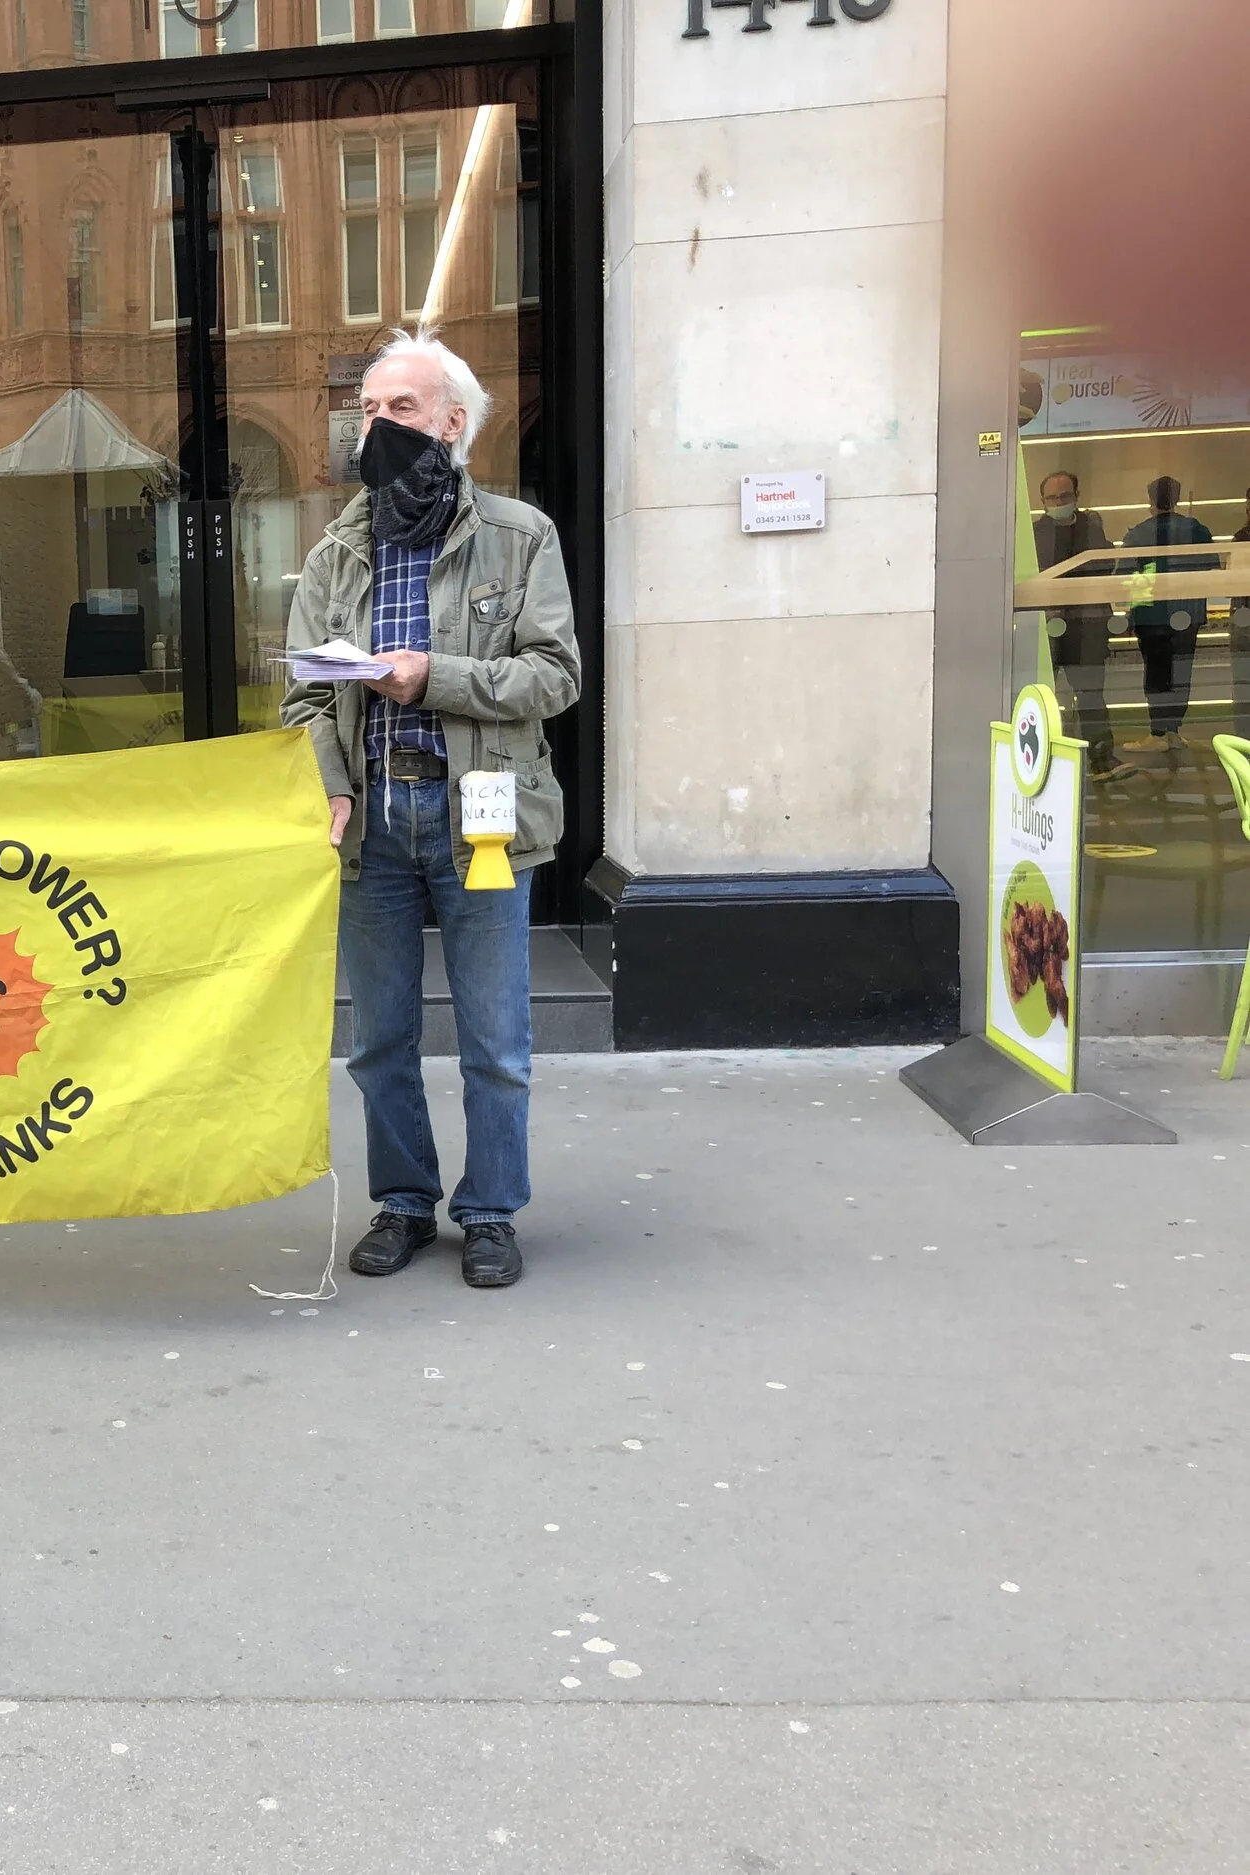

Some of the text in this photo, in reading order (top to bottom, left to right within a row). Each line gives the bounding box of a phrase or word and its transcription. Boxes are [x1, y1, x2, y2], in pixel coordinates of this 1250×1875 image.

[755, 490, 796, 502] Hartnell
[755, 516, 775, 524] 0345
[776, 515, 790, 523] 241
[186, 516, 195, 560] PUSH
[214, 514, 223, 558] PUSH
